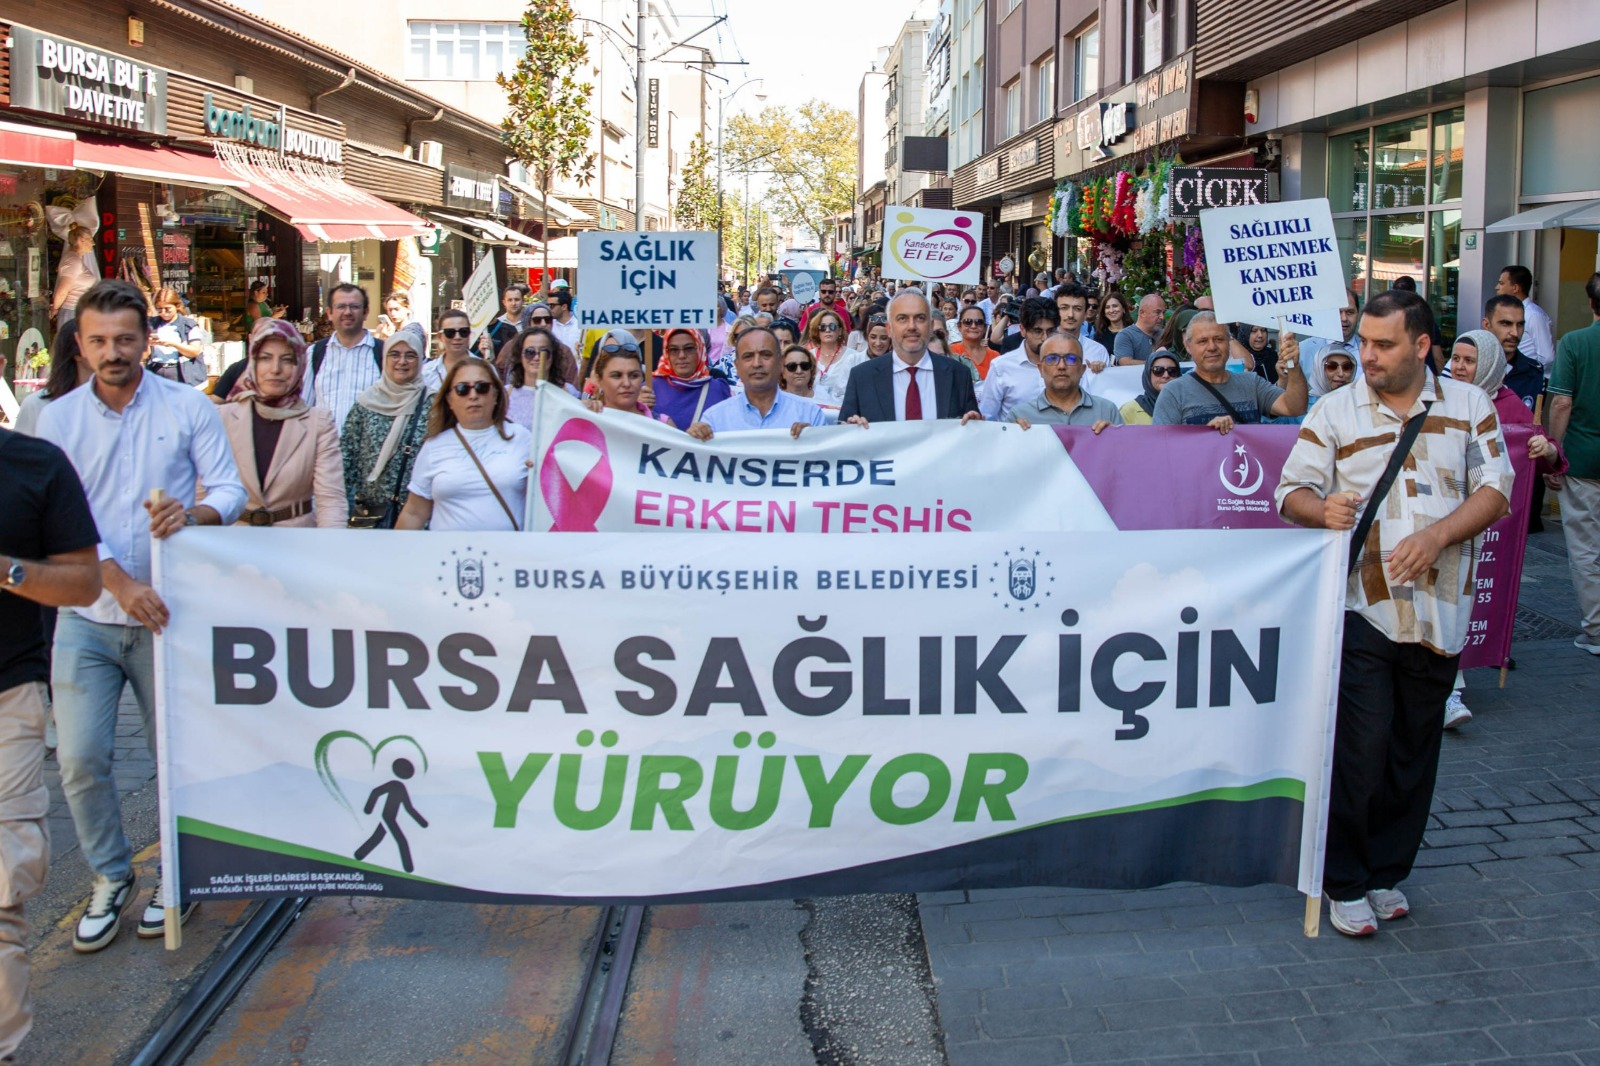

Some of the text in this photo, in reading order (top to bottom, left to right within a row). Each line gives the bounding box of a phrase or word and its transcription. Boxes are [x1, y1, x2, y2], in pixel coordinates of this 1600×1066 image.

[42, 39, 110, 83] BURSA
[69, 86, 144, 123] DAVETİYE
[1230, 217, 1311, 240] SAĞLIKLI
[600, 235, 695, 261] SAĞLIK
[904, 249, 954, 261] El Ele
[905, 239, 938, 249] Kansere
[1222, 238, 1333, 263] BESLENMEK
[621, 264, 676, 296] İÇİN
[1252, 285, 1313, 307] ÖNLER
[582, 309, 674, 325] HAREKET
[681, 309, 703, 323] ET
[637, 443, 895, 487] KANSERDE
[634, 489, 796, 532] ERKEN
[515, 564, 977, 595] BURSA BÜYÜKŞEHİR BELEDİYESİ
[1478, 592, 1492, 603] 55
[1472, 634, 1486, 645] 27
[212, 606, 1280, 741] BURSA SAĞLIK İÇİN
[476, 729, 1029, 831] YÜRÜYOR
[190, 887, 210, 895] HALK
[212, 885, 243, 894] SAĞLIĞI
[255, 884, 288, 892] SAĞLIKLI
[289, 883, 316, 892] YAŞAM
[318, 883, 336, 891] ŞUBE
[337, 882, 384, 891] MÜDÜRLÜĞÜ
[210, 872, 364, 885] SAĞLIK İŞLERİ DAİRESİ BAŞKANLIĞI
